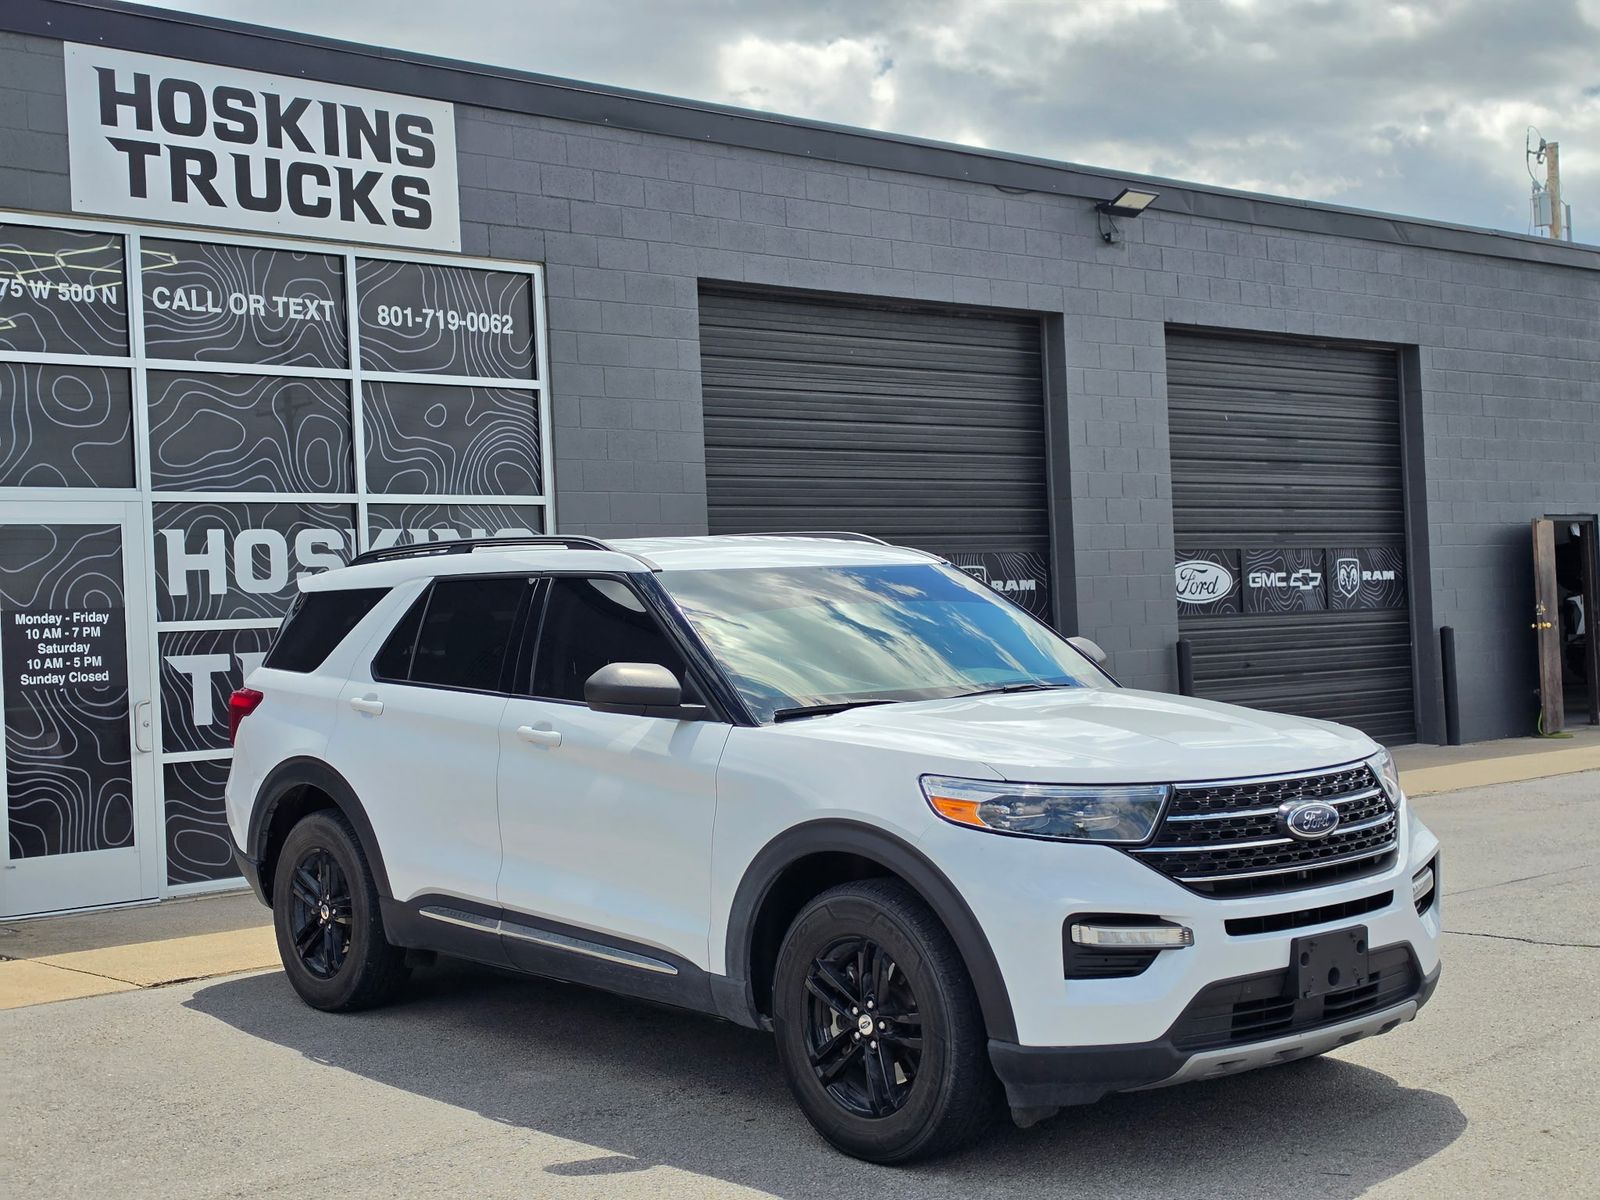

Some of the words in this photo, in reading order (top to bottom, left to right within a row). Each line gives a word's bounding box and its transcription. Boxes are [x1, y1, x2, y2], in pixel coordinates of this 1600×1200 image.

[92, 65, 436, 169] HOSKINS
[105, 136, 432, 230] TRUCKS
[29, 279, 51, 299] W
[58, 282, 96, 303] 500
[102, 286, 117, 304] N
[152, 286, 222, 313] CALL
[229, 292, 266, 317] OR
[272, 295, 335, 322] TEXT
[377, 304, 514, 335] 801-719-0062
[1176, 567, 1219, 596] Ford
[1248, 572, 1287, 588] GMC
[1362, 570, 1395, 581] RAM
[991, 579, 1036, 591] RAM
[15, 613, 62, 626] Monday
[73, 611, 109, 625] Friday
[25, 628, 40, 640] 10
[42, 627, 62, 639] AM
[72, 626, 80, 638] 7
[82, 626, 101, 638] PM
[37, 642, 91, 655] Saturday
[27, 658, 41, 670] 10
[43, 657, 63, 669] AM
[73, 656, 81, 668] 5
[83, 655, 102, 667] PM
[20, 673, 66, 686] Sunday
[68, 670, 110, 683] Closed
[1303, 810, 1330, 830] Ford
